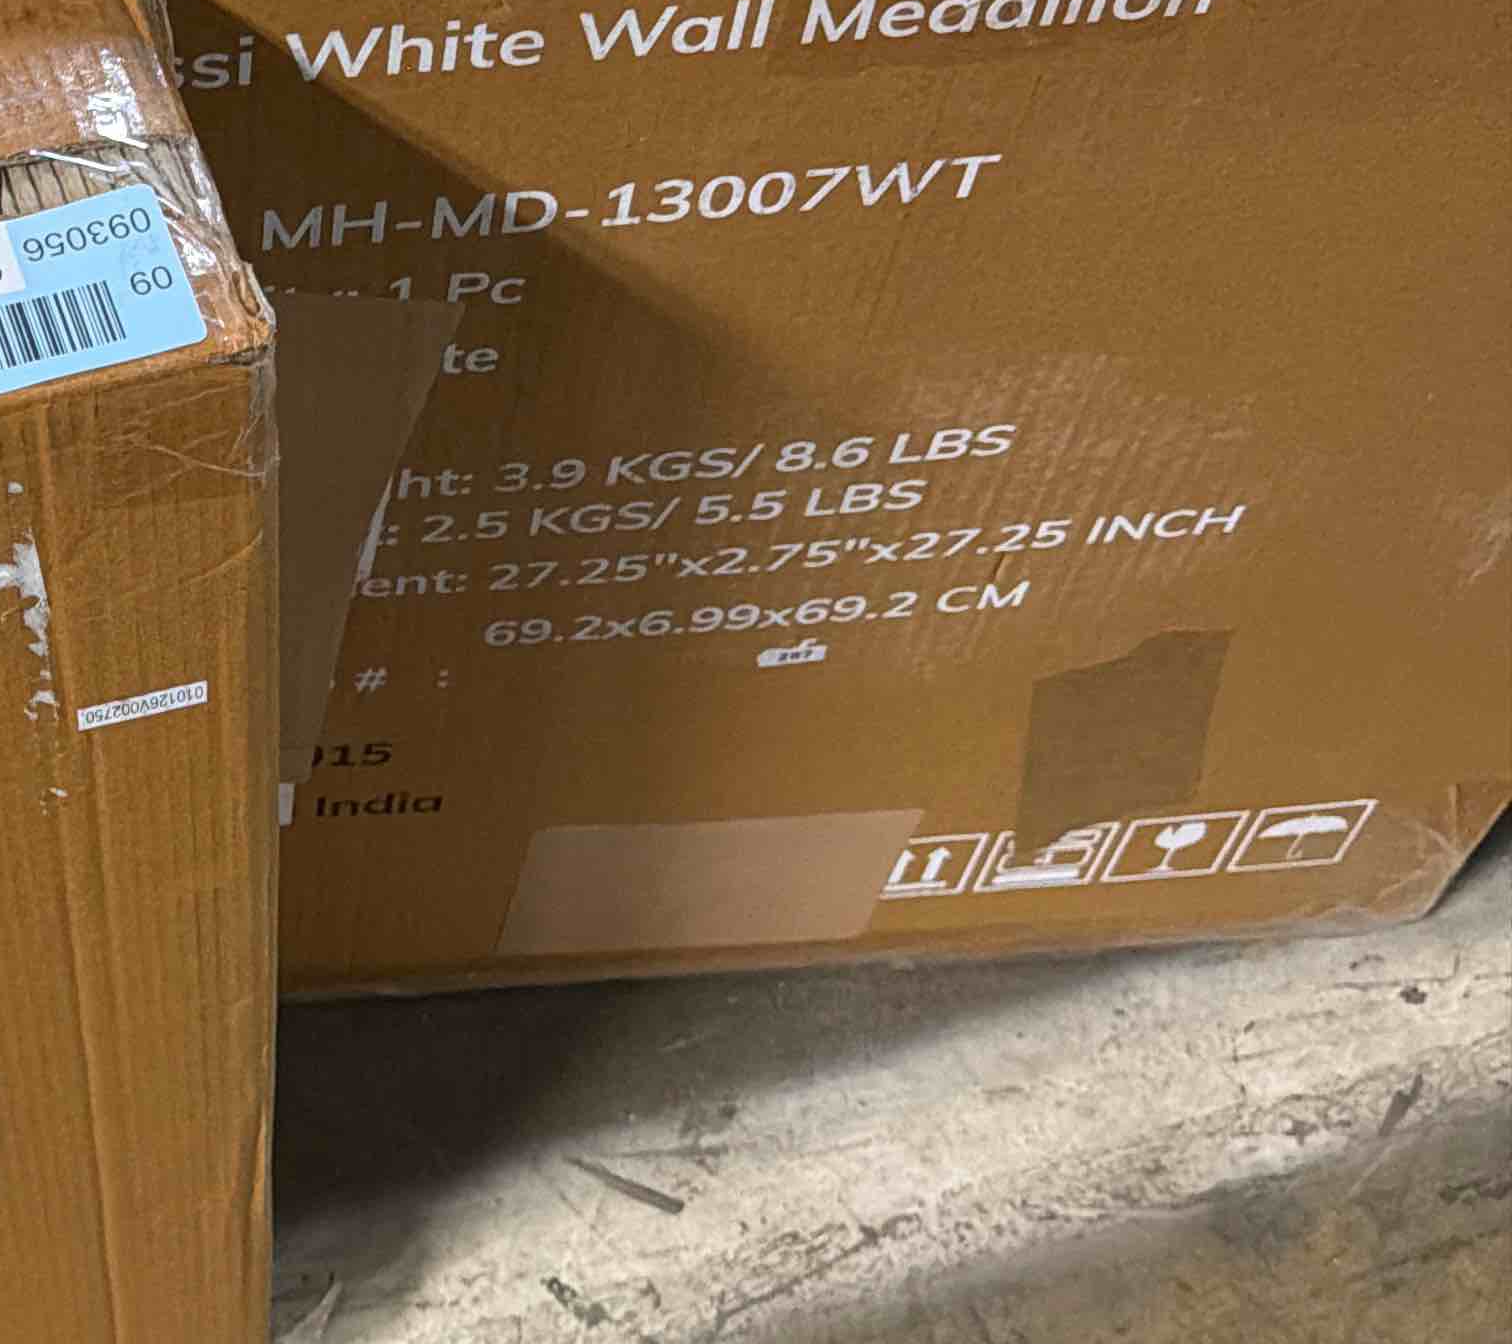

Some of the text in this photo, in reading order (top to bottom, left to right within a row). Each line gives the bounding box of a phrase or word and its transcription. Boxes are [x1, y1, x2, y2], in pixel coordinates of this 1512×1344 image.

[284, 19, 546, 82] White
[21, 206, 152, 263] 093056
[261, 153, 1003, 253] MH-MD-13007WT
[129, 265, 174, 296] 09
[446, 271, 527, 305] Pc
[493, 458, 586, 494] 3.9
[603, 443, 766, 488] KGS/
[775, 436, 875, 473] 8.6
[888, 423, 1018, 465] LBS
[419, 511, 510, 544] 2.5
[528, 496, 683, 538] KGS/
[694, 490, 788, 526] 5.5
[803, 479, 929, 518] LBS
[359, 569, 469, 598] ent:
[1086, 504, 1248, 546] INCH
[482, 580, 1031, 647] 69.2x6.99x69.2 CM
[314, 789, 444, 818] India
